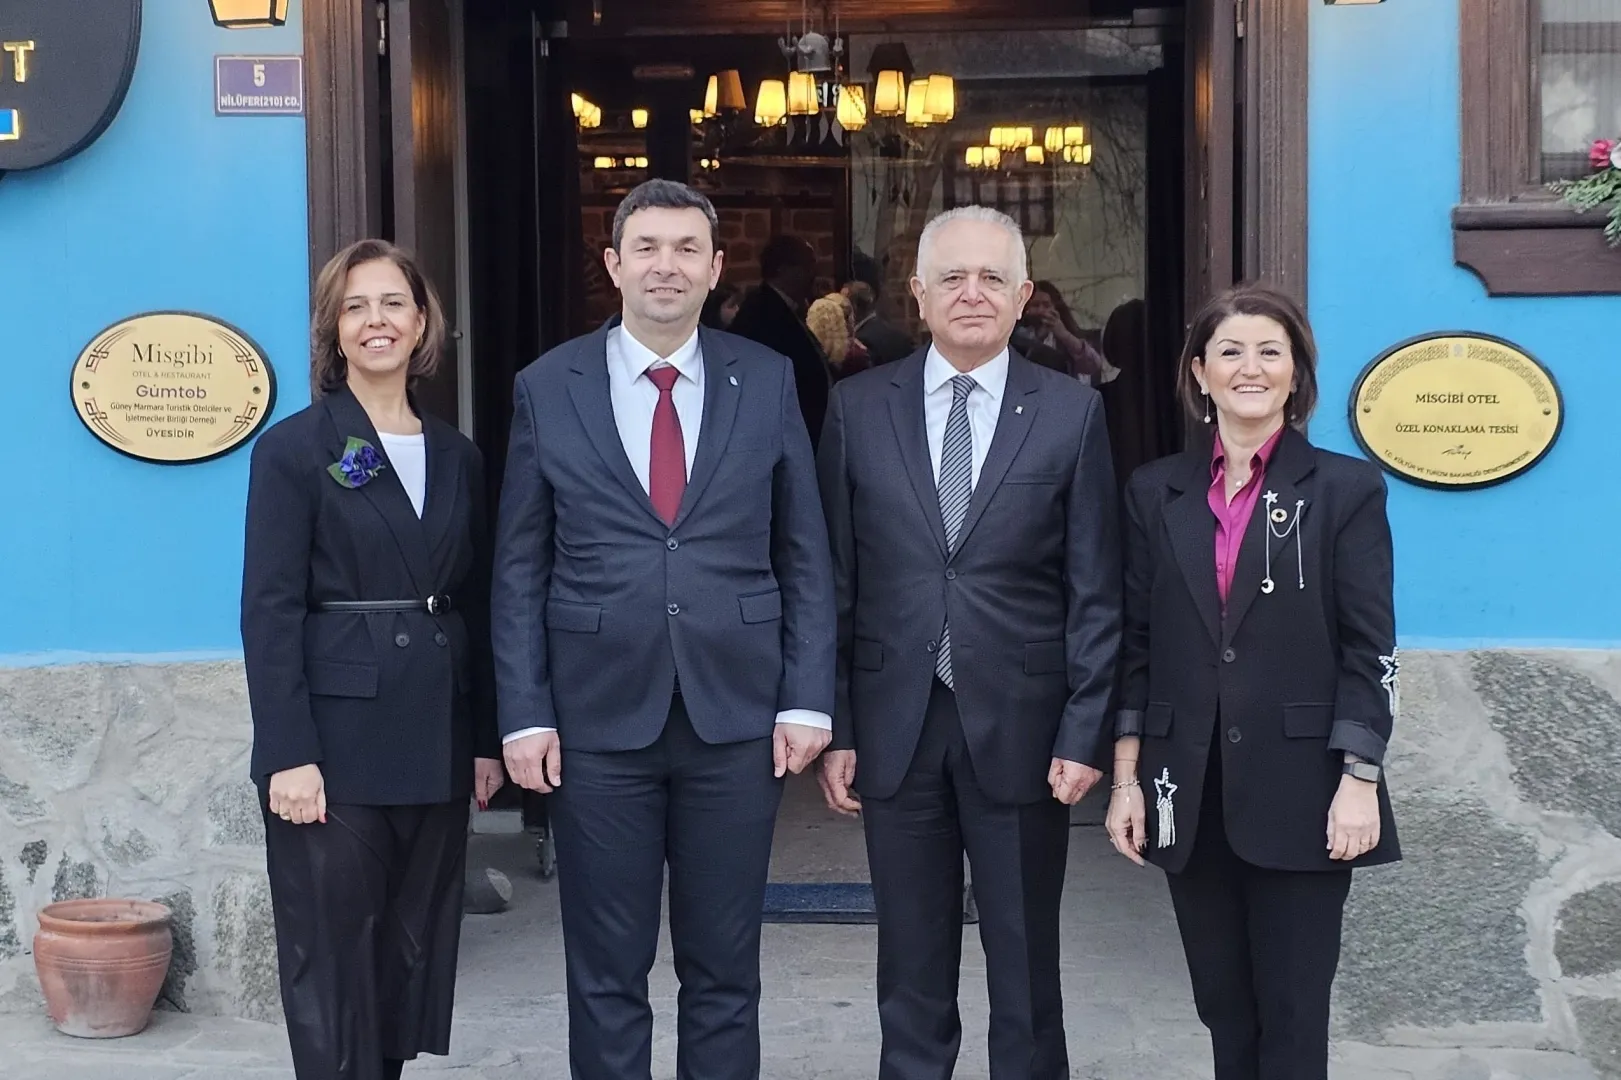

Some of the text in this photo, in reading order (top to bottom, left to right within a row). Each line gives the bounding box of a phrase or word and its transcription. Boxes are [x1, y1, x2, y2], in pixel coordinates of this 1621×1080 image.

[253, 63, 265, 87] 5
[132, 343, 213, 368] Misgibi
[132, 370, 152, 378] OTEL
[161, 372, 212, 380] RESTAURANT
[1415, 392, 1500, 404] MİSGİBİ OTEL
[110, 402, 232, 413] Güney Marmara Turistik Otelciler ve
[125, 412, 217, 425] İşletmeciler Birliği Derneği
[146, 427, 195, 439] ÜYESİDİR
[1395, 423, 1519, 434] ÖZEL KONAKLAMA TESİSİ
